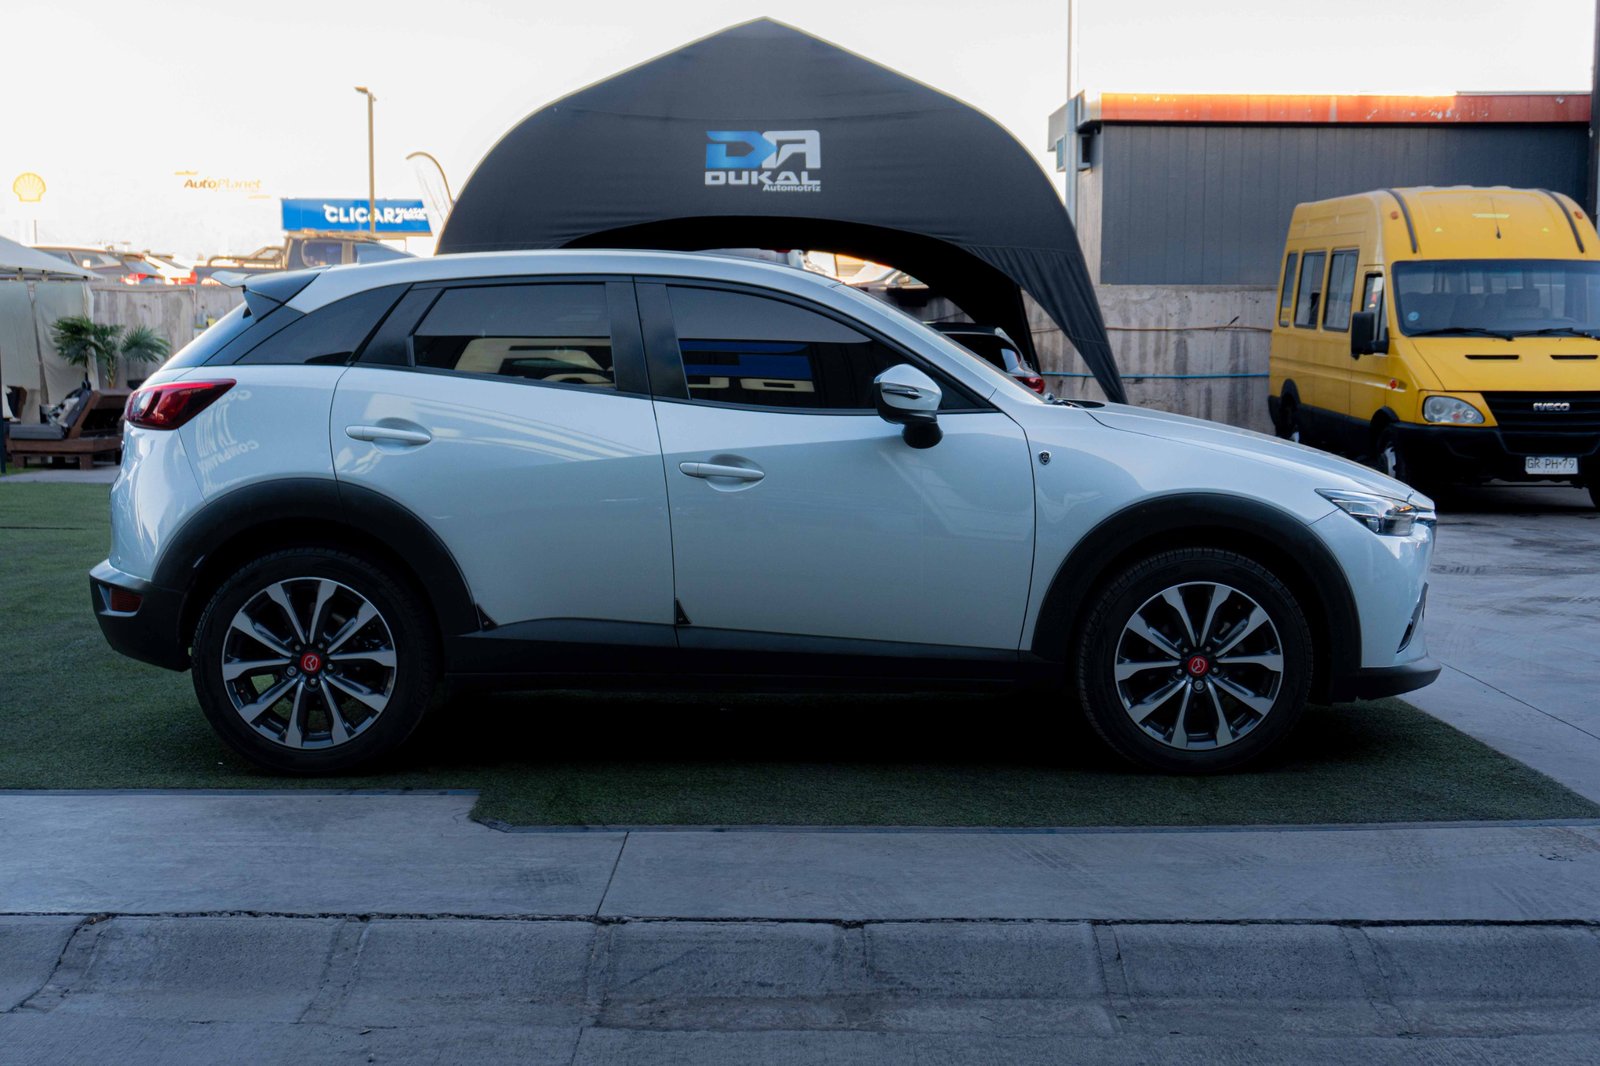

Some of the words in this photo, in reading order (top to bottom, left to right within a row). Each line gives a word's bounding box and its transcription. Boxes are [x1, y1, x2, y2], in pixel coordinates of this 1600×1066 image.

[705, 171, 821, 185] DUKAL
[762, 184, 821, 192] Automotriz
[1533, 403, 1570, 411] IVECO
